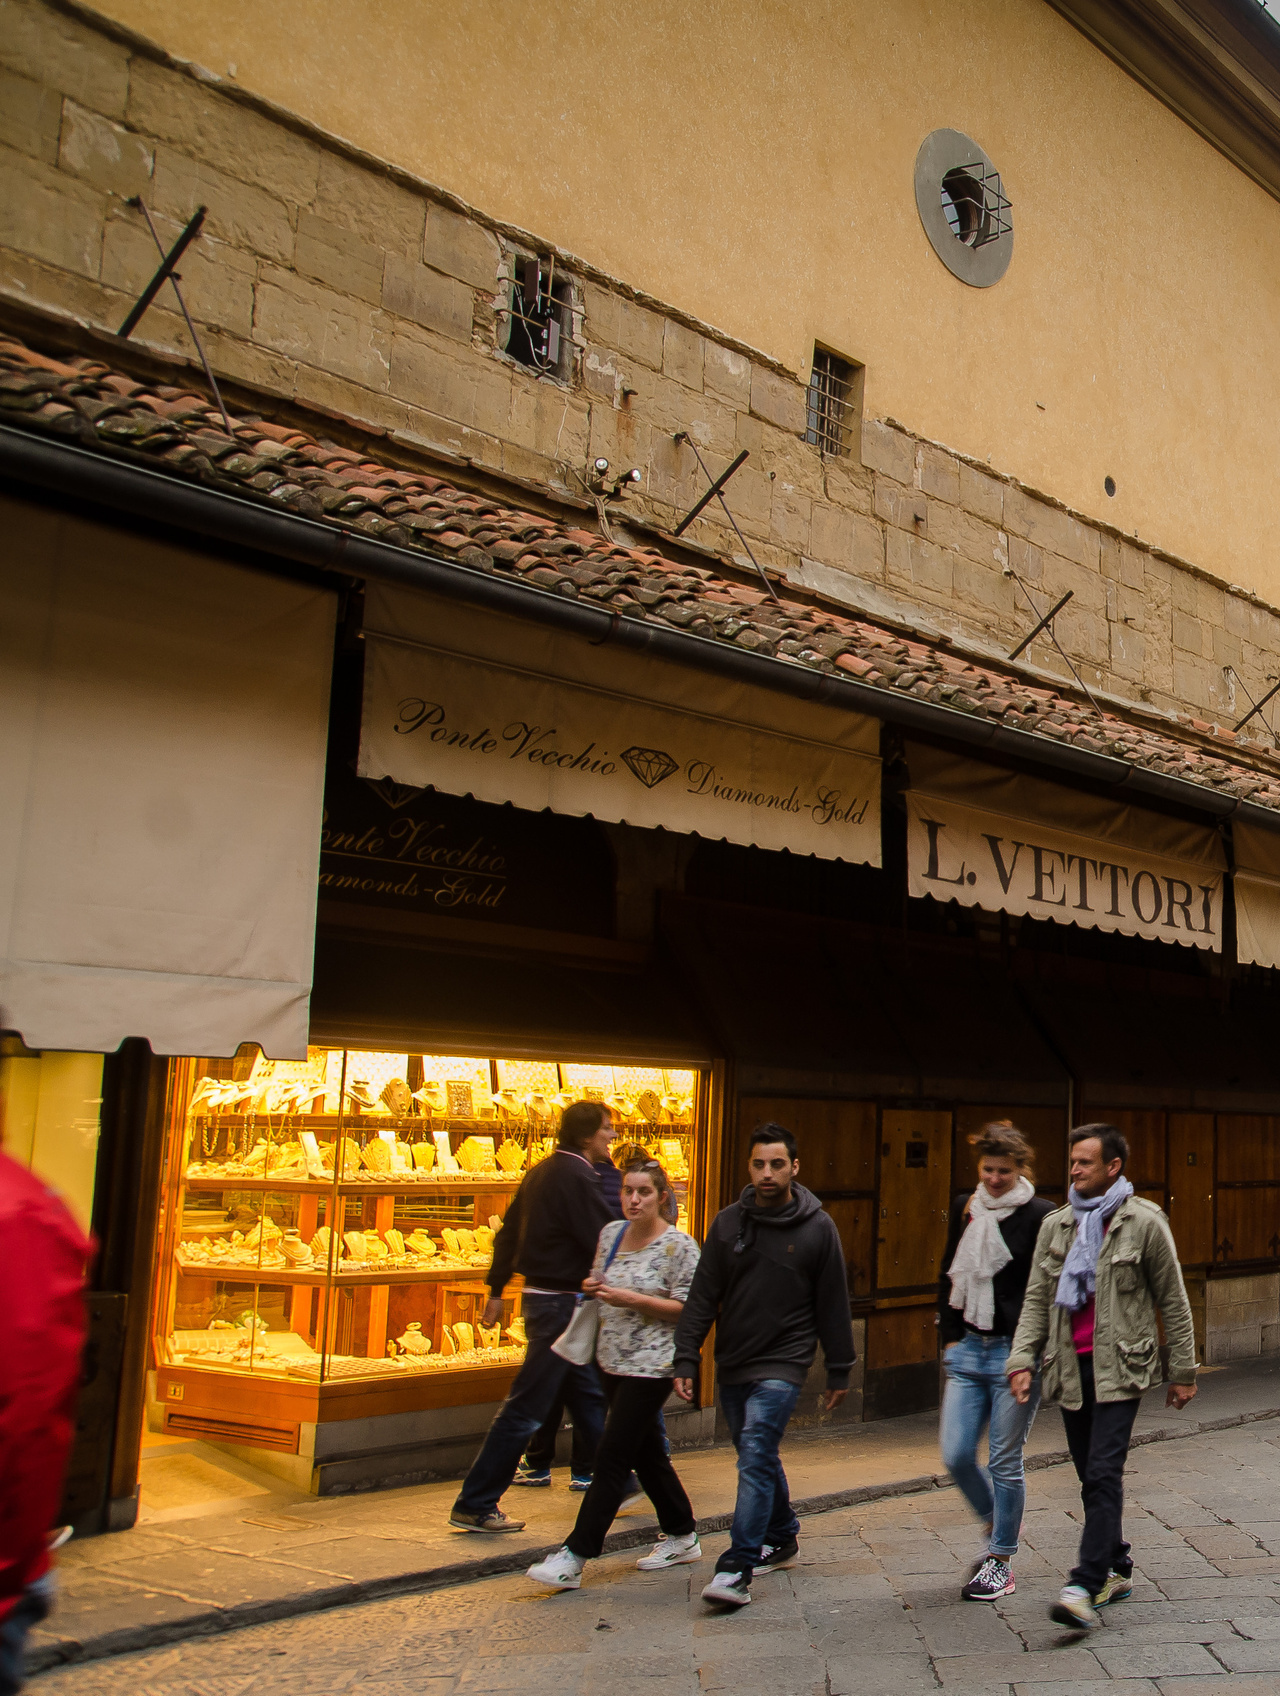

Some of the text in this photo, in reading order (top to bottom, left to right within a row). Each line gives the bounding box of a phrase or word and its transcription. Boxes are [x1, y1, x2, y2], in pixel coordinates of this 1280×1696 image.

[393, 697, 498, 753] Ponte
[501, 721, 618, 776] Vecchio
[320, 808, 507, 870] onte Vecchio
[319, 872, 505, 908] amonds-Gold
[919, 818, 1216, 935] L. VETTORI
